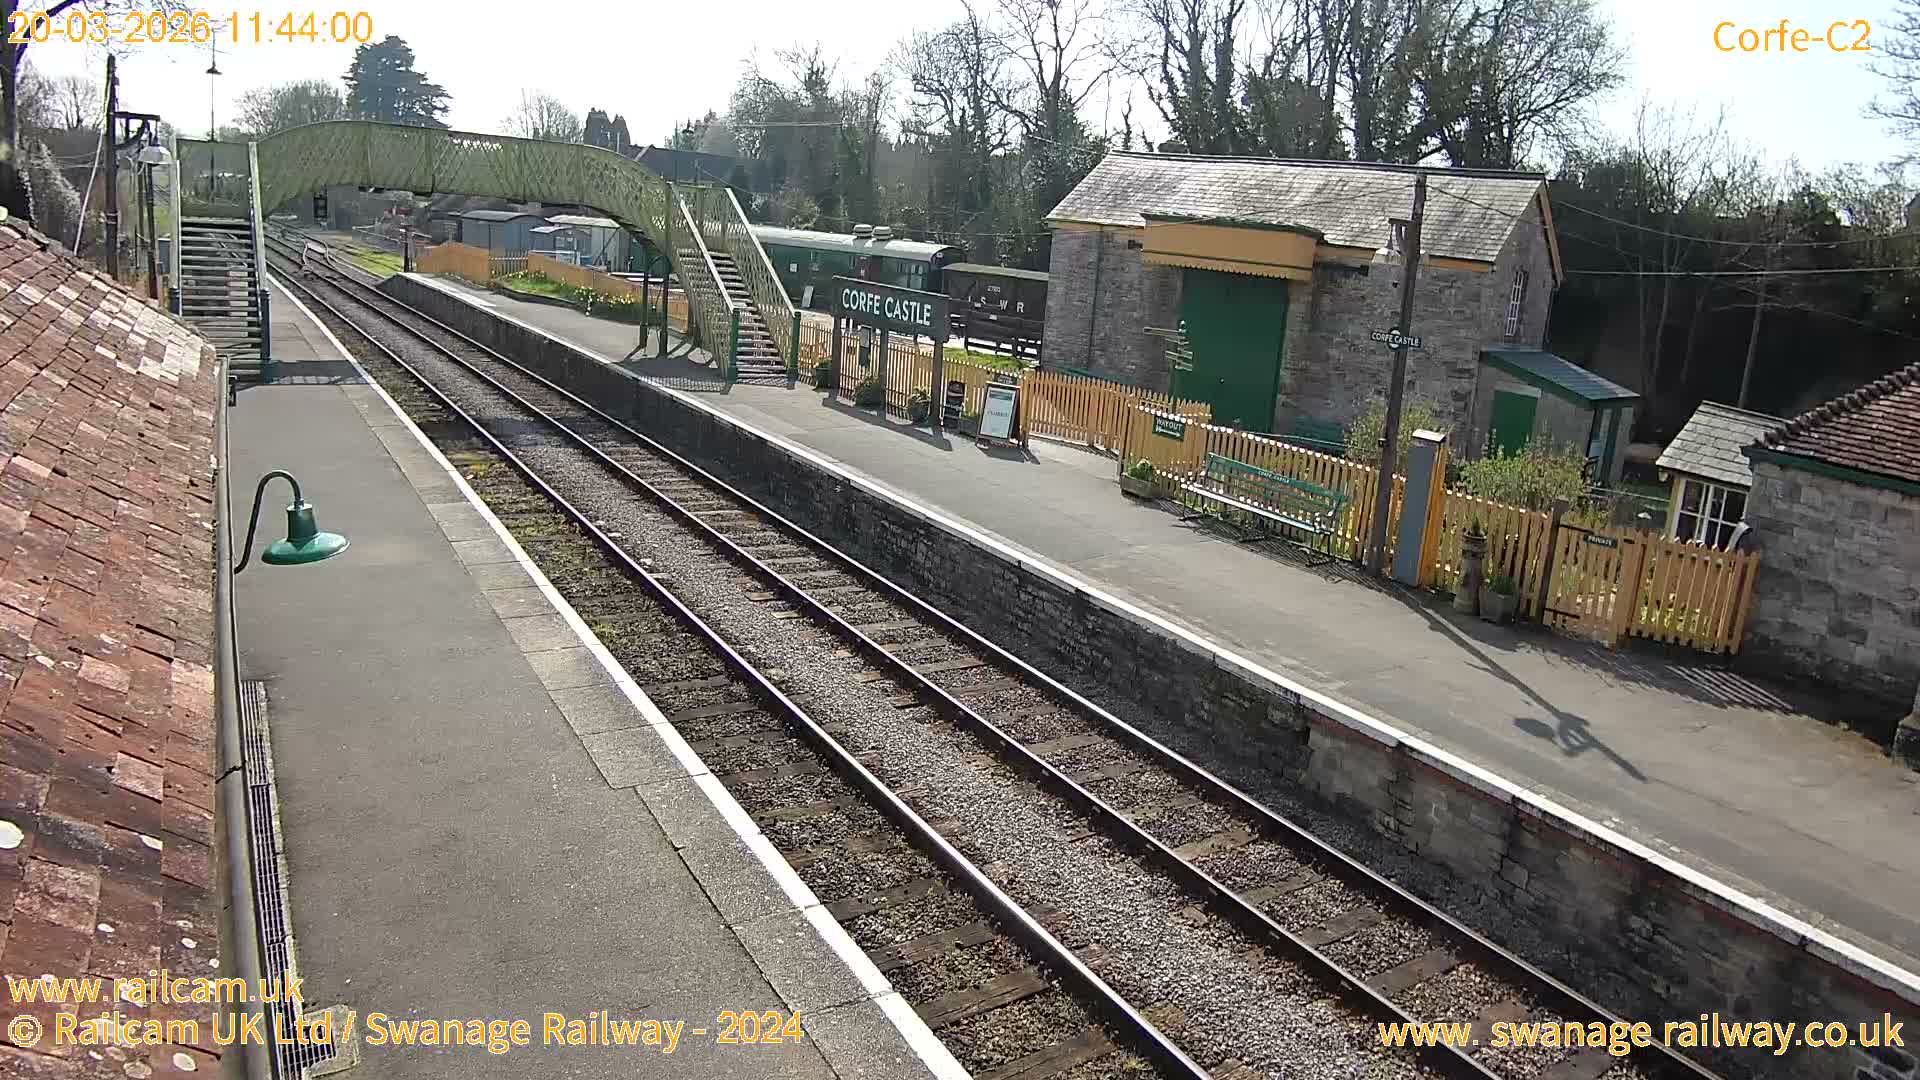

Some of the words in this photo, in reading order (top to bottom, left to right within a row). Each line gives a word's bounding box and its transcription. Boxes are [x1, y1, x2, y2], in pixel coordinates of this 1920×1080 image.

[842, 288, 880, 315] CORFE
[884, 296, 931, 326] CASTLE
[1371, 332, 1393, 343] CORFE
[1394, 335, 1420, 347] CASTLE
